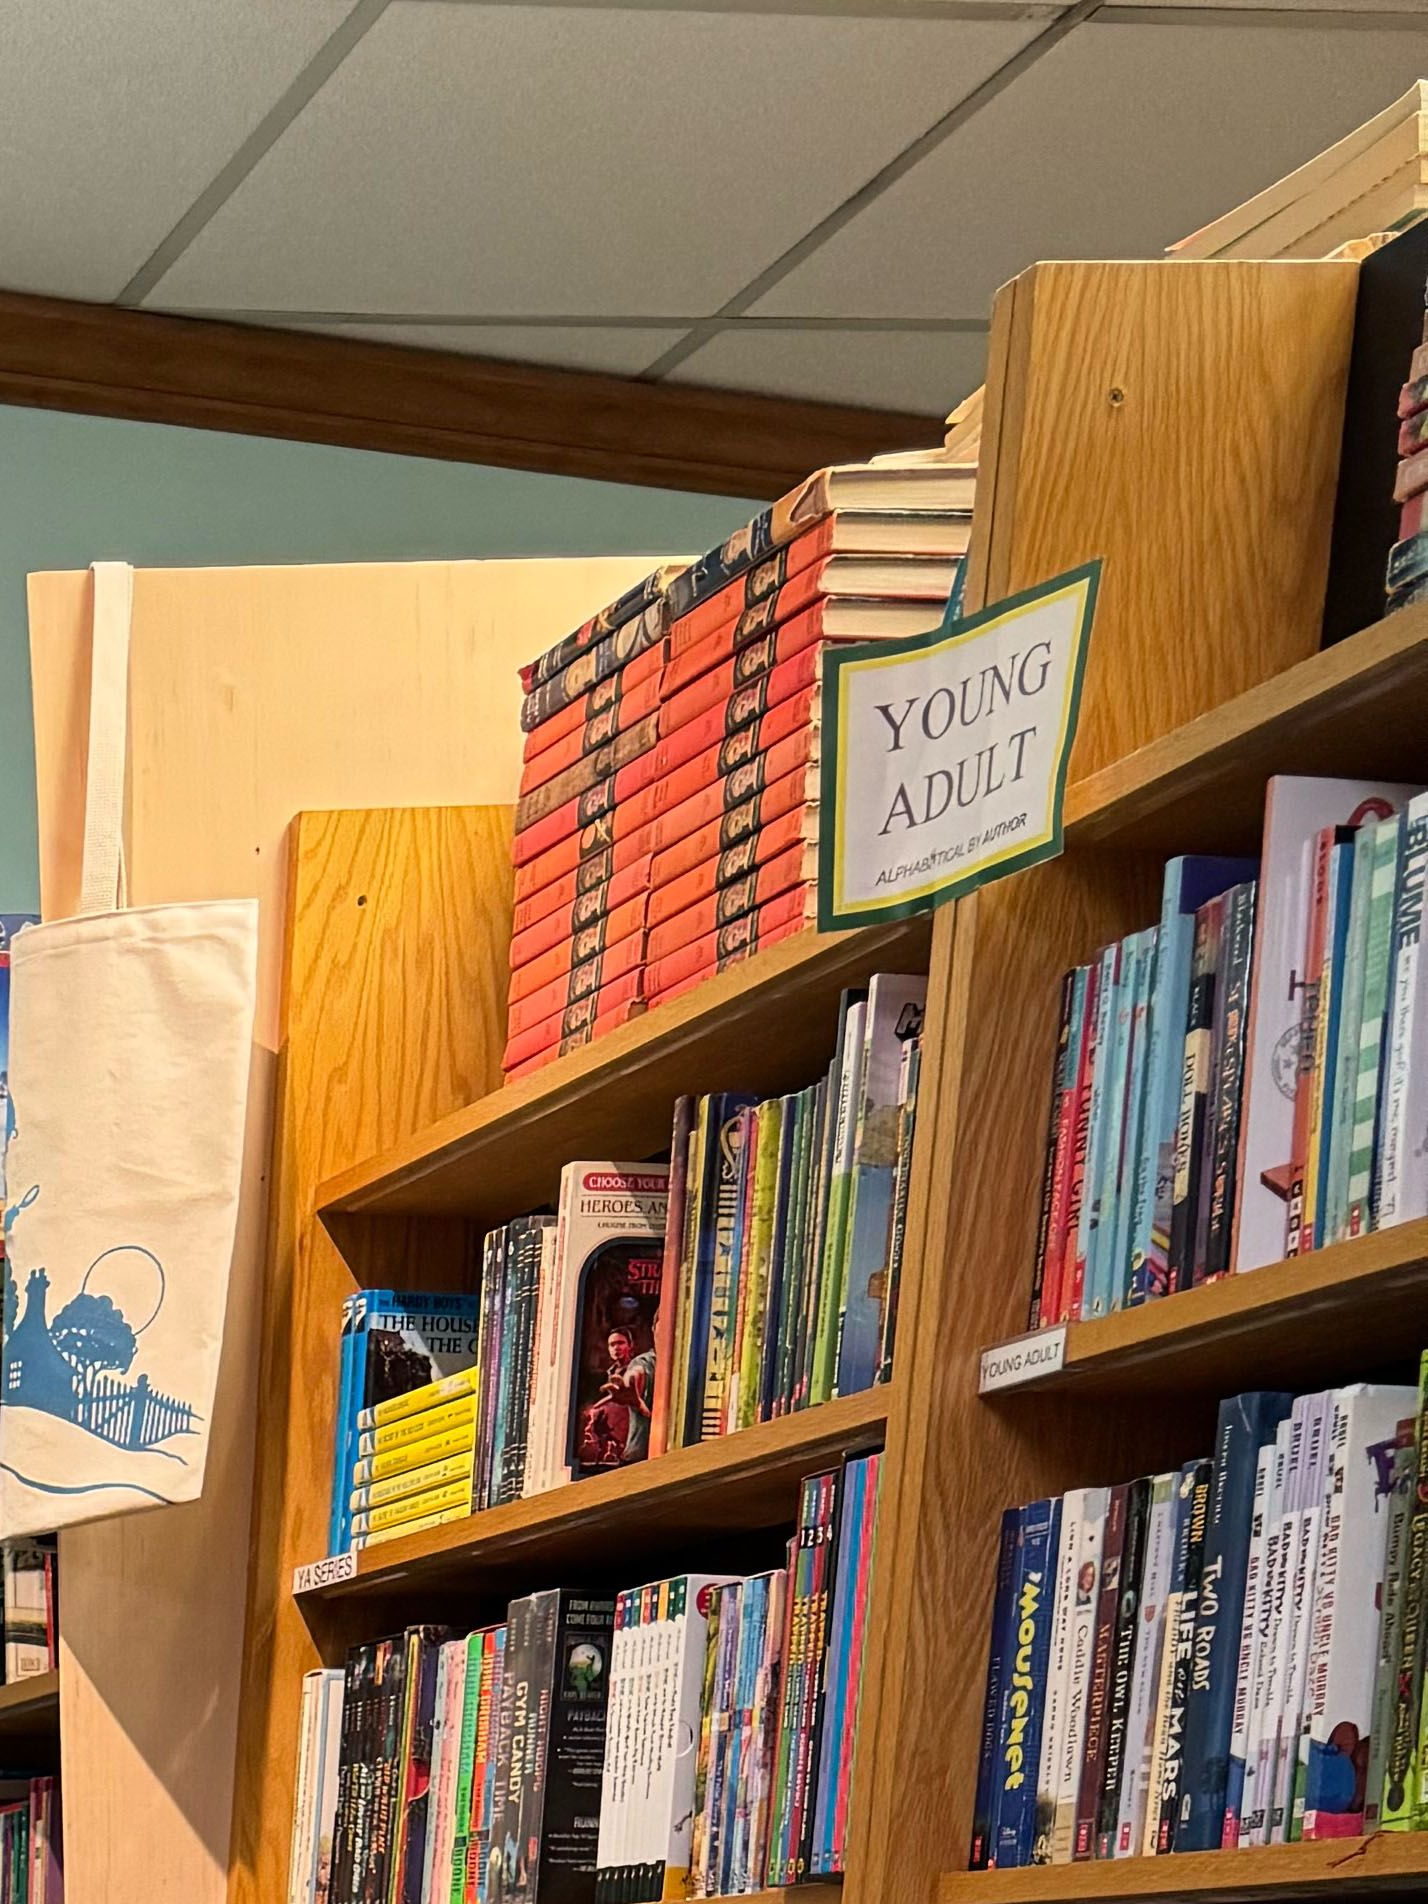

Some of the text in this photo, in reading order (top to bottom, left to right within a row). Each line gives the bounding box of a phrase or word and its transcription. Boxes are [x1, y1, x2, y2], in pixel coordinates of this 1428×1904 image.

[874, 640, 1052, 752] YOUNG
[878, 727, 1036, 836] ADULT
[967, 836, 982, 856] BY
[981, 812, 1028, 847] AUTHOR
[1400, 820, 1428, 950] BLUME
[1183, 1051, 1197, 1114] DOLL
[580, 1199, 643, 1214] HEROES
[588, 1176, 634, 1189] CHOOSE
[382, 1315, 415, 1330] THE
[980, 1345, 1061, 1380] YOUNG ADULT
[1190, 1483, 1209, 1545] BROWN
[297, 1556, 353, 1592] YA SERIES
[1192, 1555, 1223, 1691] TWO ROADS
[1085, 1622, 1111, 1763] MASTERPIECE
[1161, 1589, 1198, 1802] LIFE MARS
[508, 1681, 528, 1804] GYM CANDY
[524, 1712, 537, 1774] RUNNER
